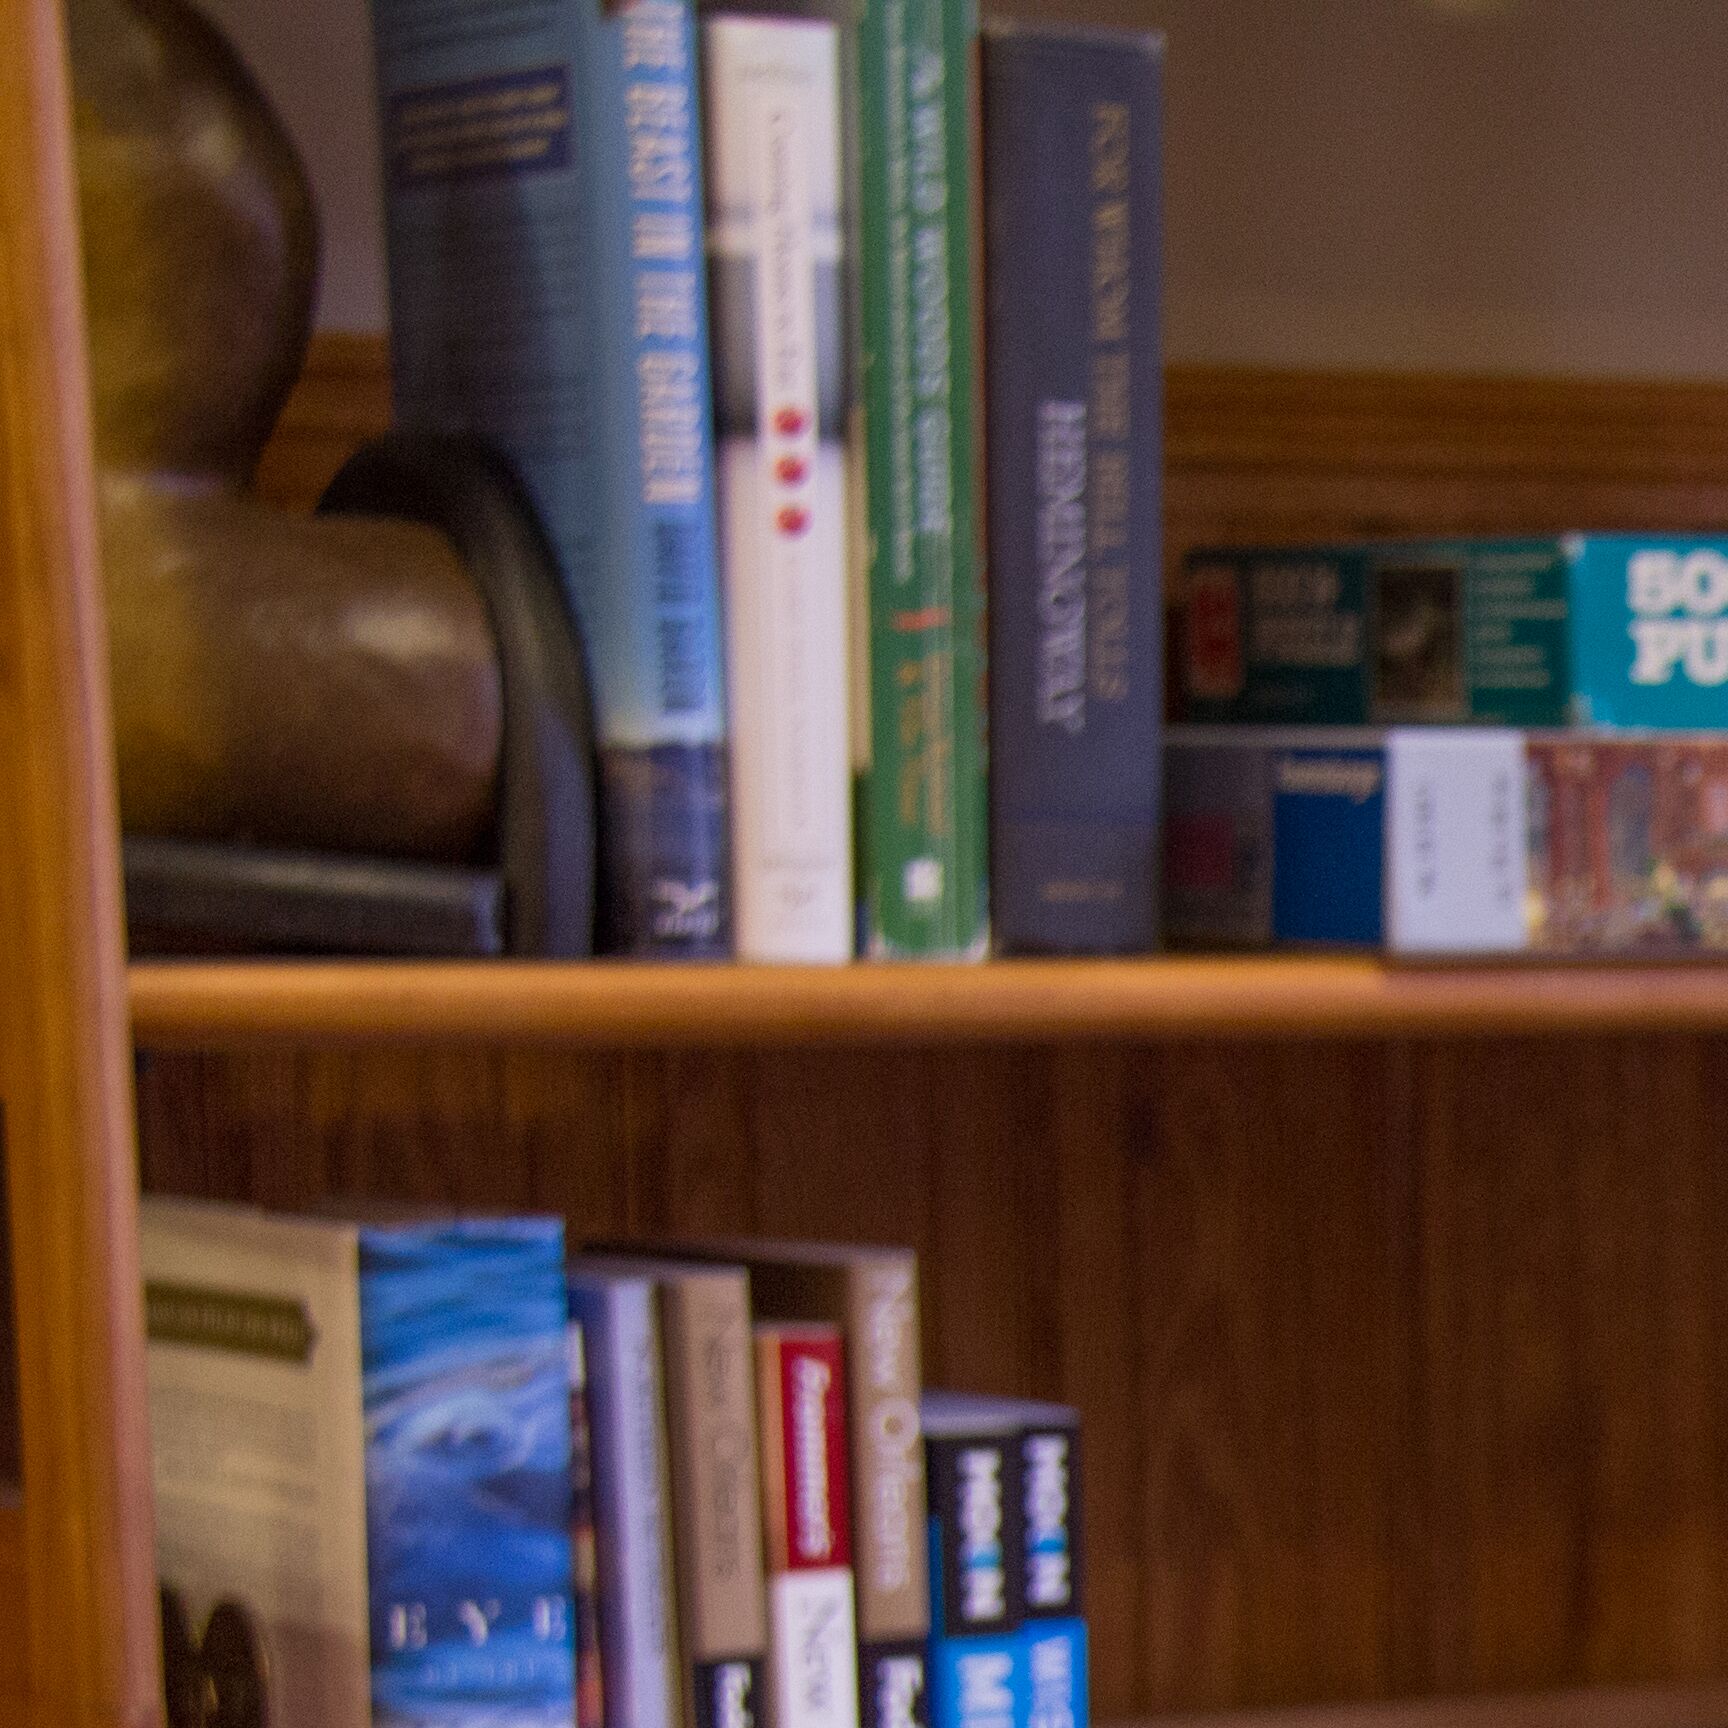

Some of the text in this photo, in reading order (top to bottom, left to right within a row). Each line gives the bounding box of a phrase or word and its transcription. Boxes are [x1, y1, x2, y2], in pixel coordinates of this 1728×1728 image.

[625, 82, 695, 202] BEAST
[912, 102, 947, 214] WILD
[631, 213, 697, 259] IN
[634, 271, 699, 339] THE
[912, 227, 949, 398] WOODS
[637, 352, 706, 505] GARDEN
[1089, 102, 1132, 704] FOR WHOM THE BELL TOLLS
[1035, 400, 1089, 734] HEMINGWAY
[868, 1264, 922, 1593] New Orleans
[799, 1596, 845, 1714] New
